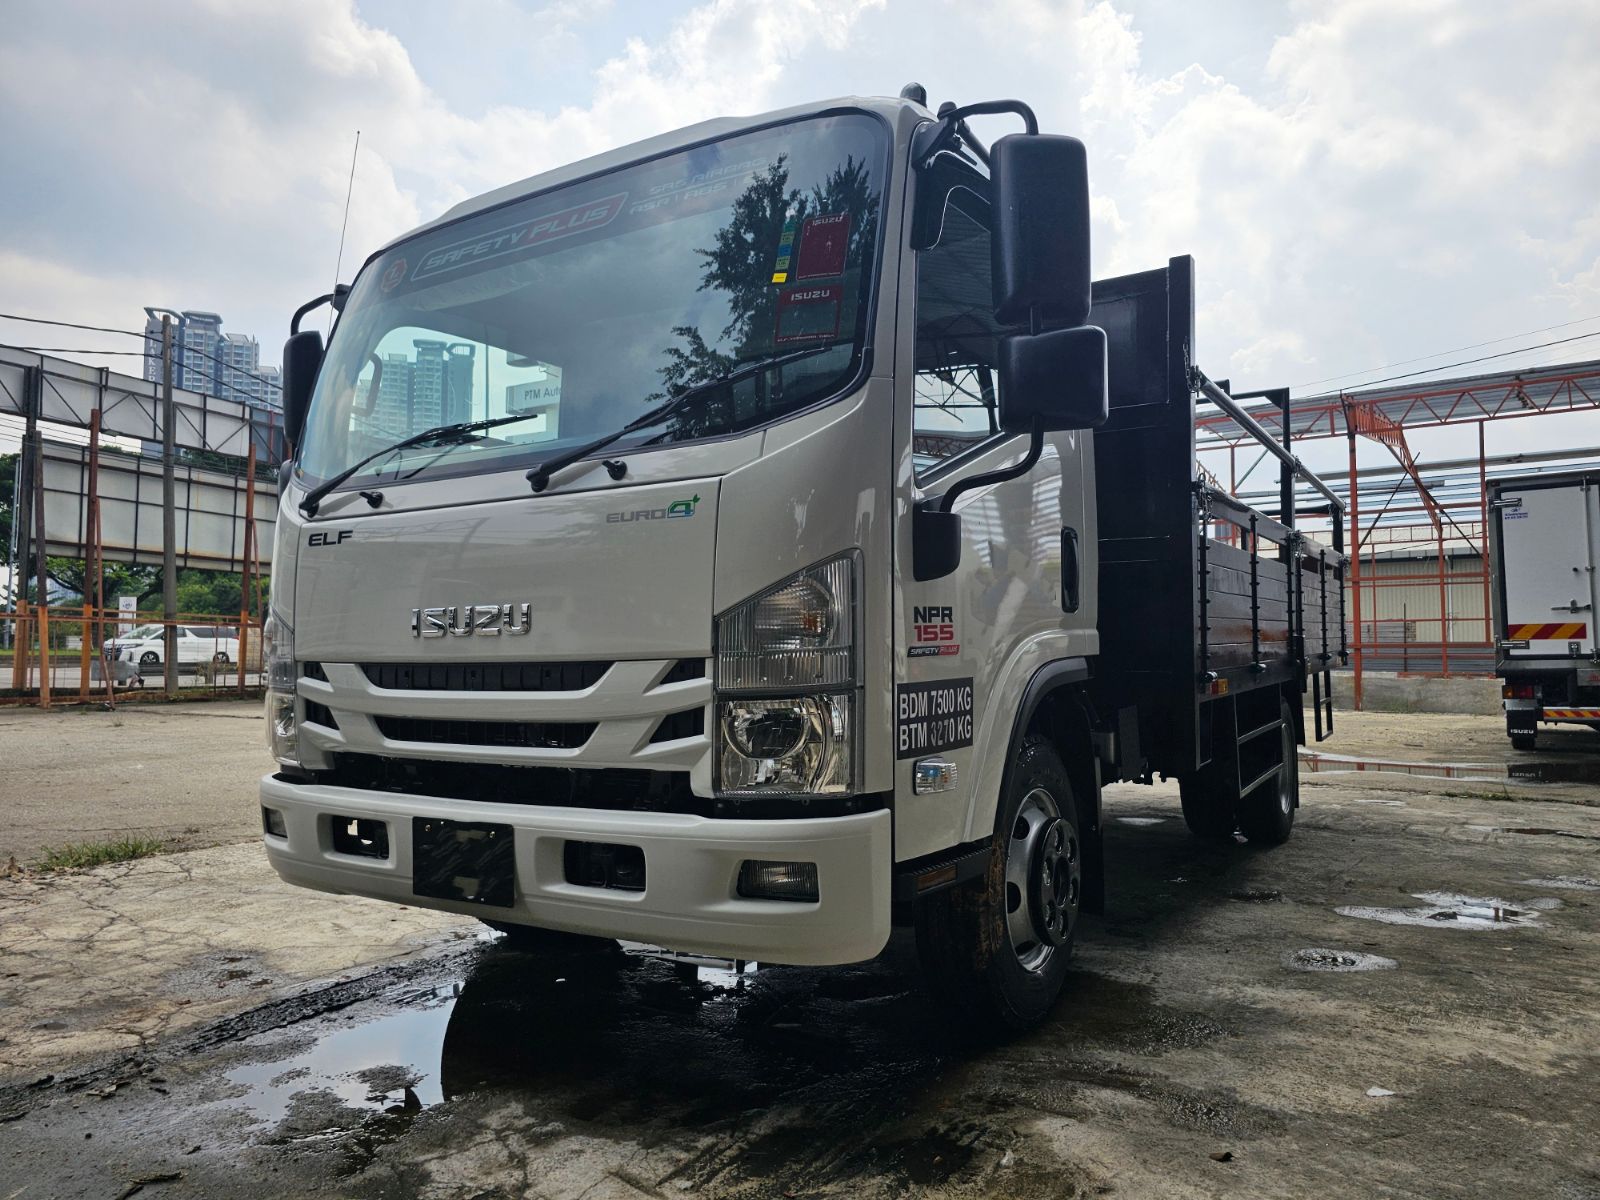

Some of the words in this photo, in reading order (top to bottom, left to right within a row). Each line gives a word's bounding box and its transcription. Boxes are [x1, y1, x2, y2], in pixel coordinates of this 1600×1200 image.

[812, 217, 843, 226] ISUZU
[423, 229, 529, 270] SAFETY
[528, 205, 611, 239] PLUS
[791, 289, 830, 301] ISUZU
[524, 389, 541, 400] PTM
[308, 530, 353, 547] ELF
[411, 603, 532, 638] ISUZU
[913, 606, 954, 623] NPR
[914, 624, 954, 642] 155
[910, 647, 939, 655] SAFETY
[900, 691, 928, 719] BDM
[931, 689, 955, 716] 7500
[957, 686, 971, 711] KG
[900, 722, 928, 751] BTM
[930, 718, 955, 747] 3270
[957, 714, 972, 740] KG
